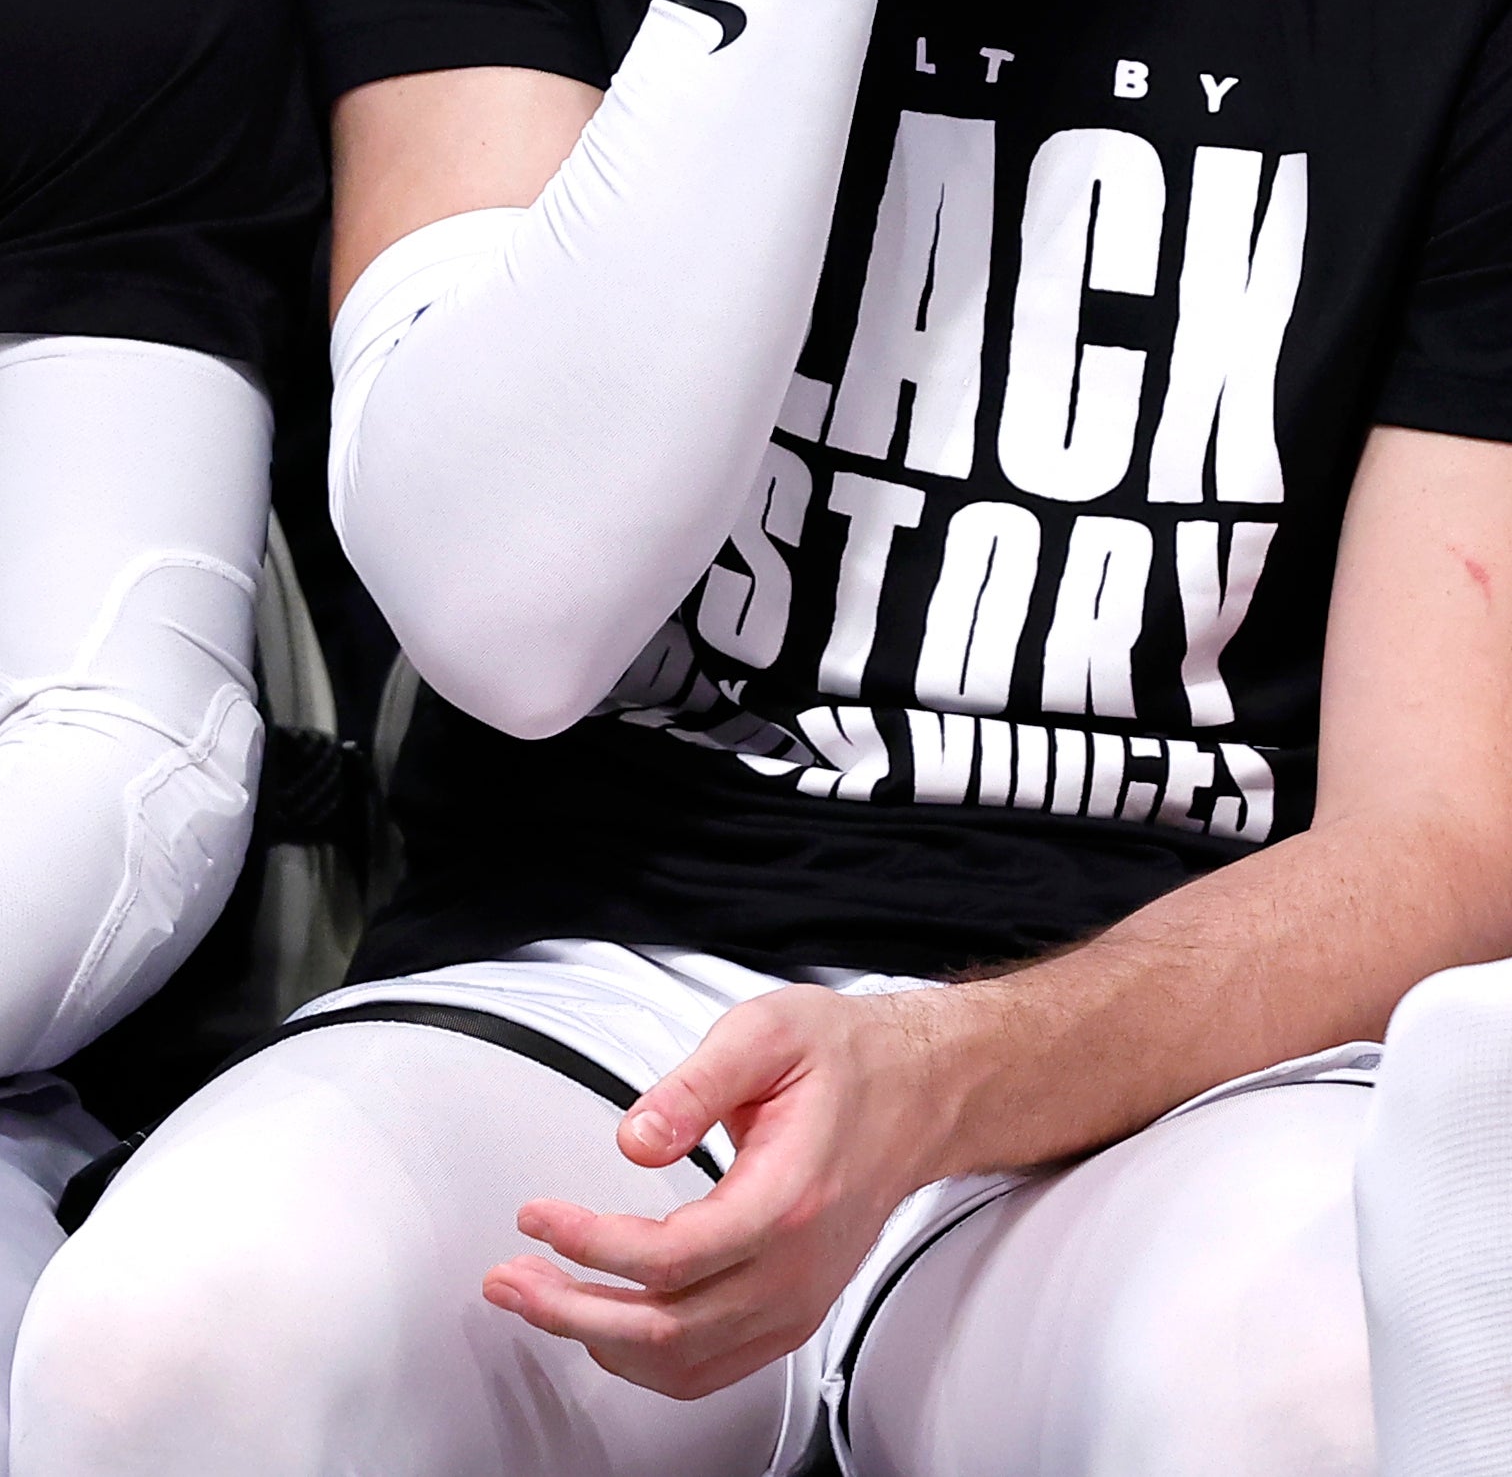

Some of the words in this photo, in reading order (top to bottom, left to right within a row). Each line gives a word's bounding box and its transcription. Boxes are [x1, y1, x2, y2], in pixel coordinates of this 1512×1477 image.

[1113, 59, 1239, 113] BY
[772, 110, 1308, 503] ACK
[697, 440, 1278, 727] STORY
